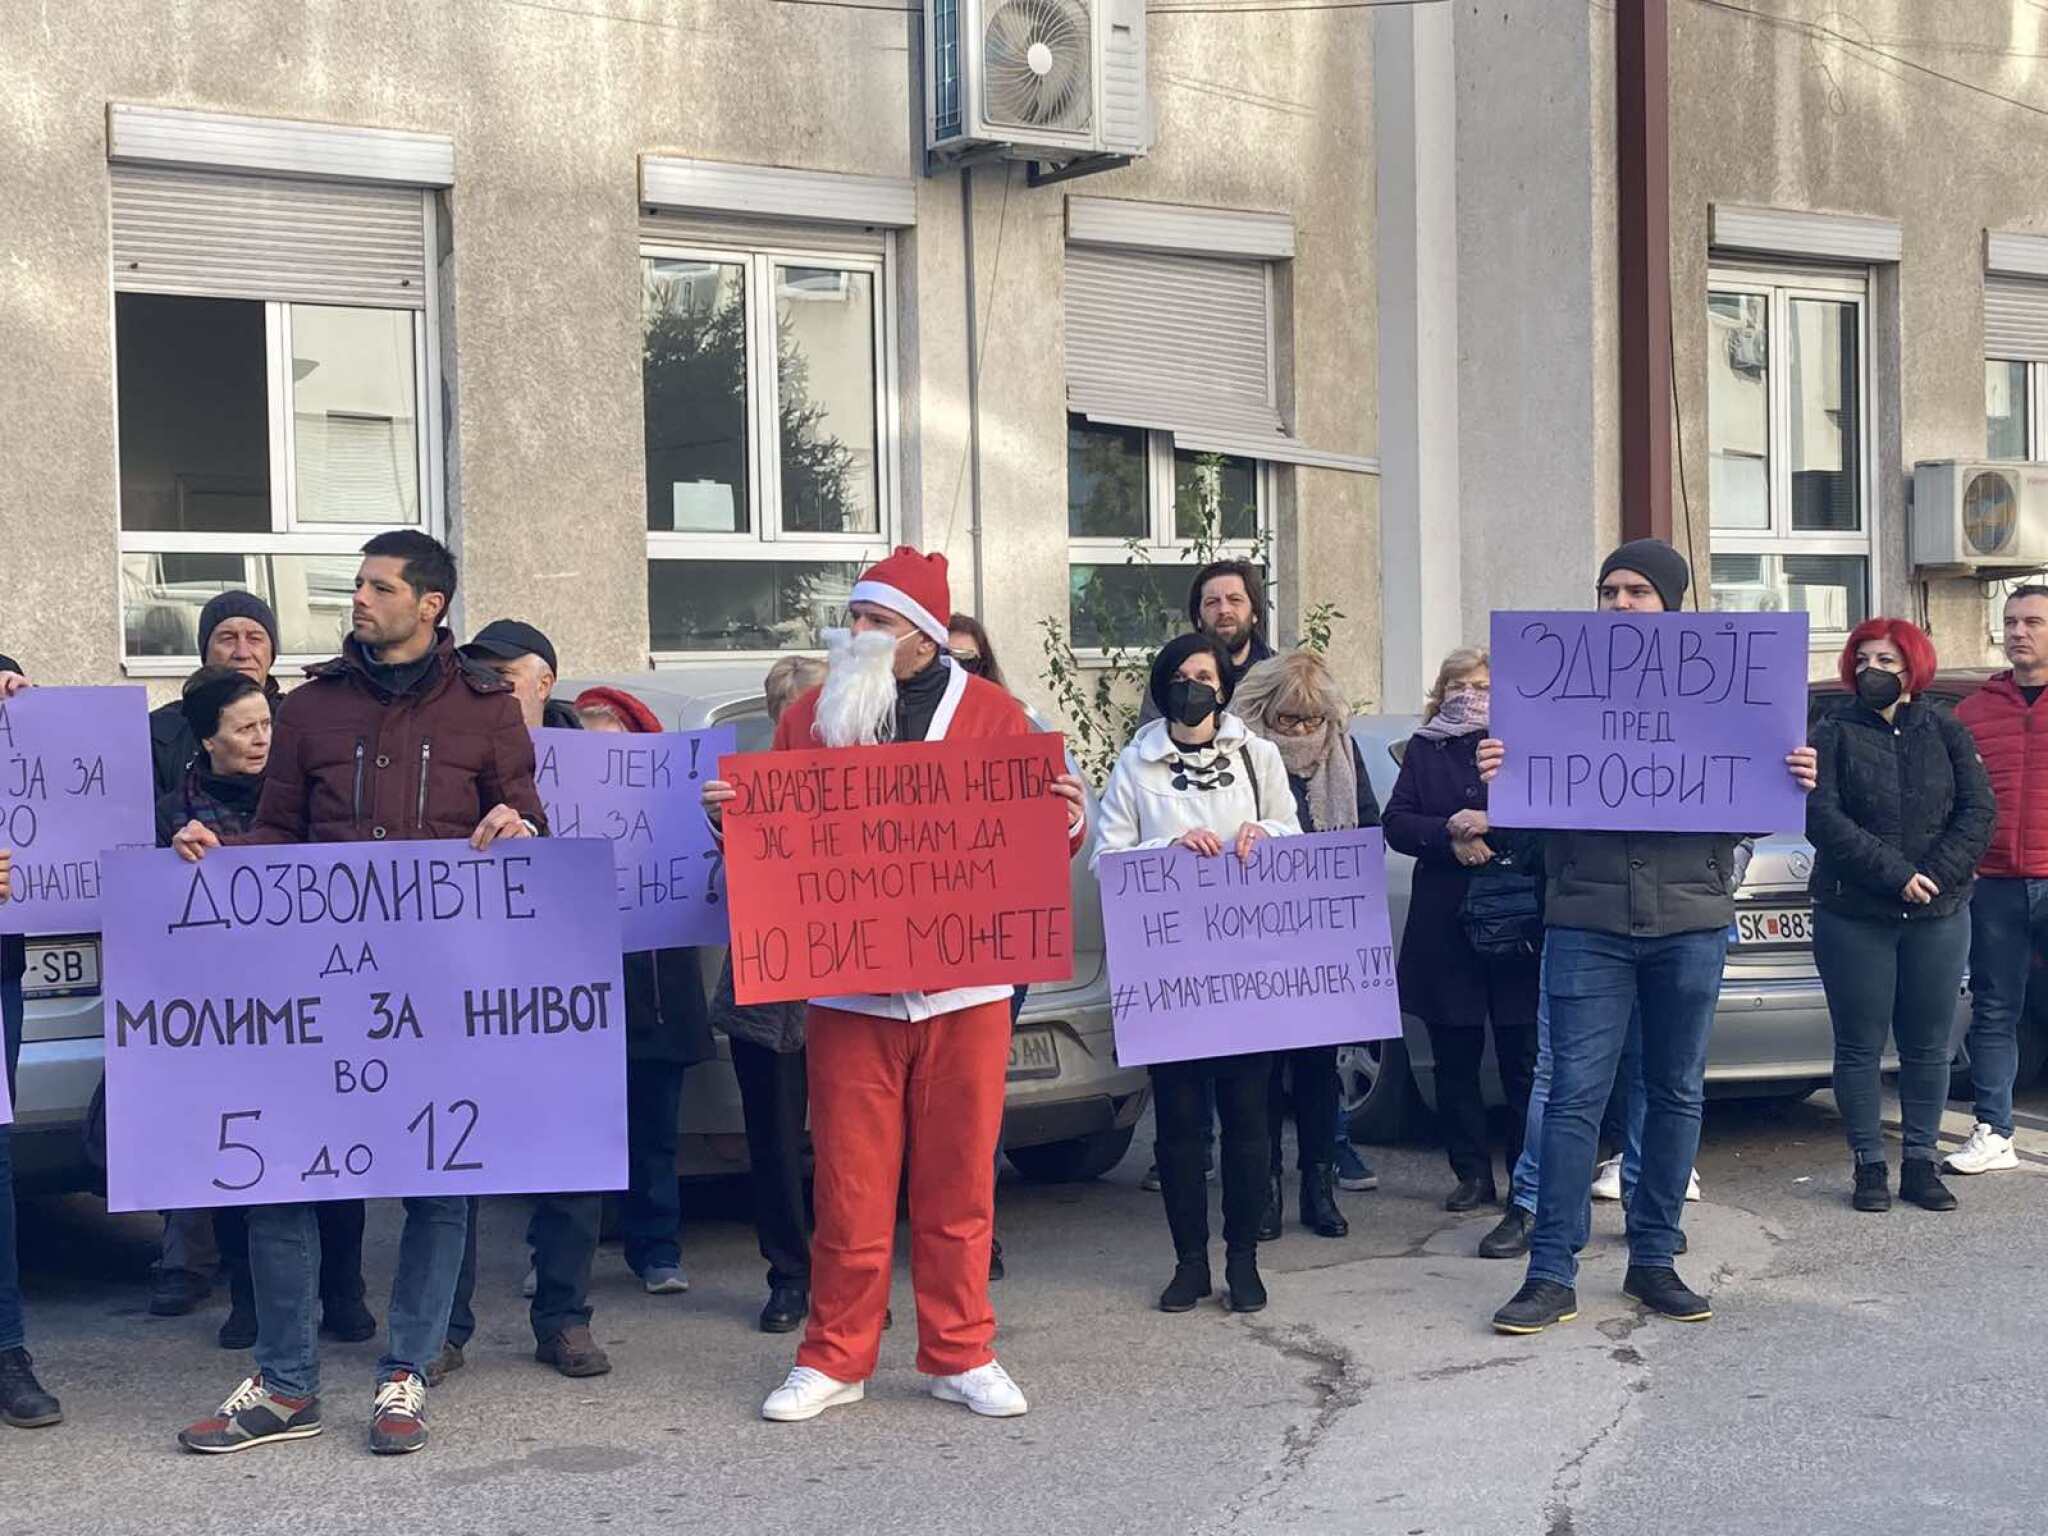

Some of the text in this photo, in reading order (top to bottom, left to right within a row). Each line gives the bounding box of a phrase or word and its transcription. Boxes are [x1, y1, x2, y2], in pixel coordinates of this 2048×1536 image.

[1516, 621, 1777, 704] ЗДРАВЈЕ
[1602, 711, 1675, 742] ПРЕД
[65, 755, 105, 796] ЗА
[727, 762, 839, 820] ЗДРАВЈЕ
[865, 763, 948, 806] НИВНА
[1528, 752, 1751, 808] ПРОФИТ
[602, 809, 654, 843] ЗА
[754, 822, 793, 861] ЈАС
[811, 823, 841, 857] НЕ
[968, 818, 1007, 851] ДА
[168, 857, 535, 934] ДОЗВОЛИВТЕ
[797, 859, 997, 905] ПОМОГНАМ
[1117, 844, 1368, 896] ЛЕК Е ПРИОРИТЕТ
[738, 907, 1066, 985] НО ВИЕ МОЖЕТЕ
[1143, 896, 1366, 947] НЕ КОМОДИТЕТ
[1740, 914, 1767, 940] SK
[320, 942, 379, 978] ДА
[116, 982, 612, 1047] МОЛИМЕ ЗА ЖИВОТ
[334, 1059, 388, 1093] ВО
[212, 1111, 265, 1190] 5
[407, 1100, 483, 1172] 12
